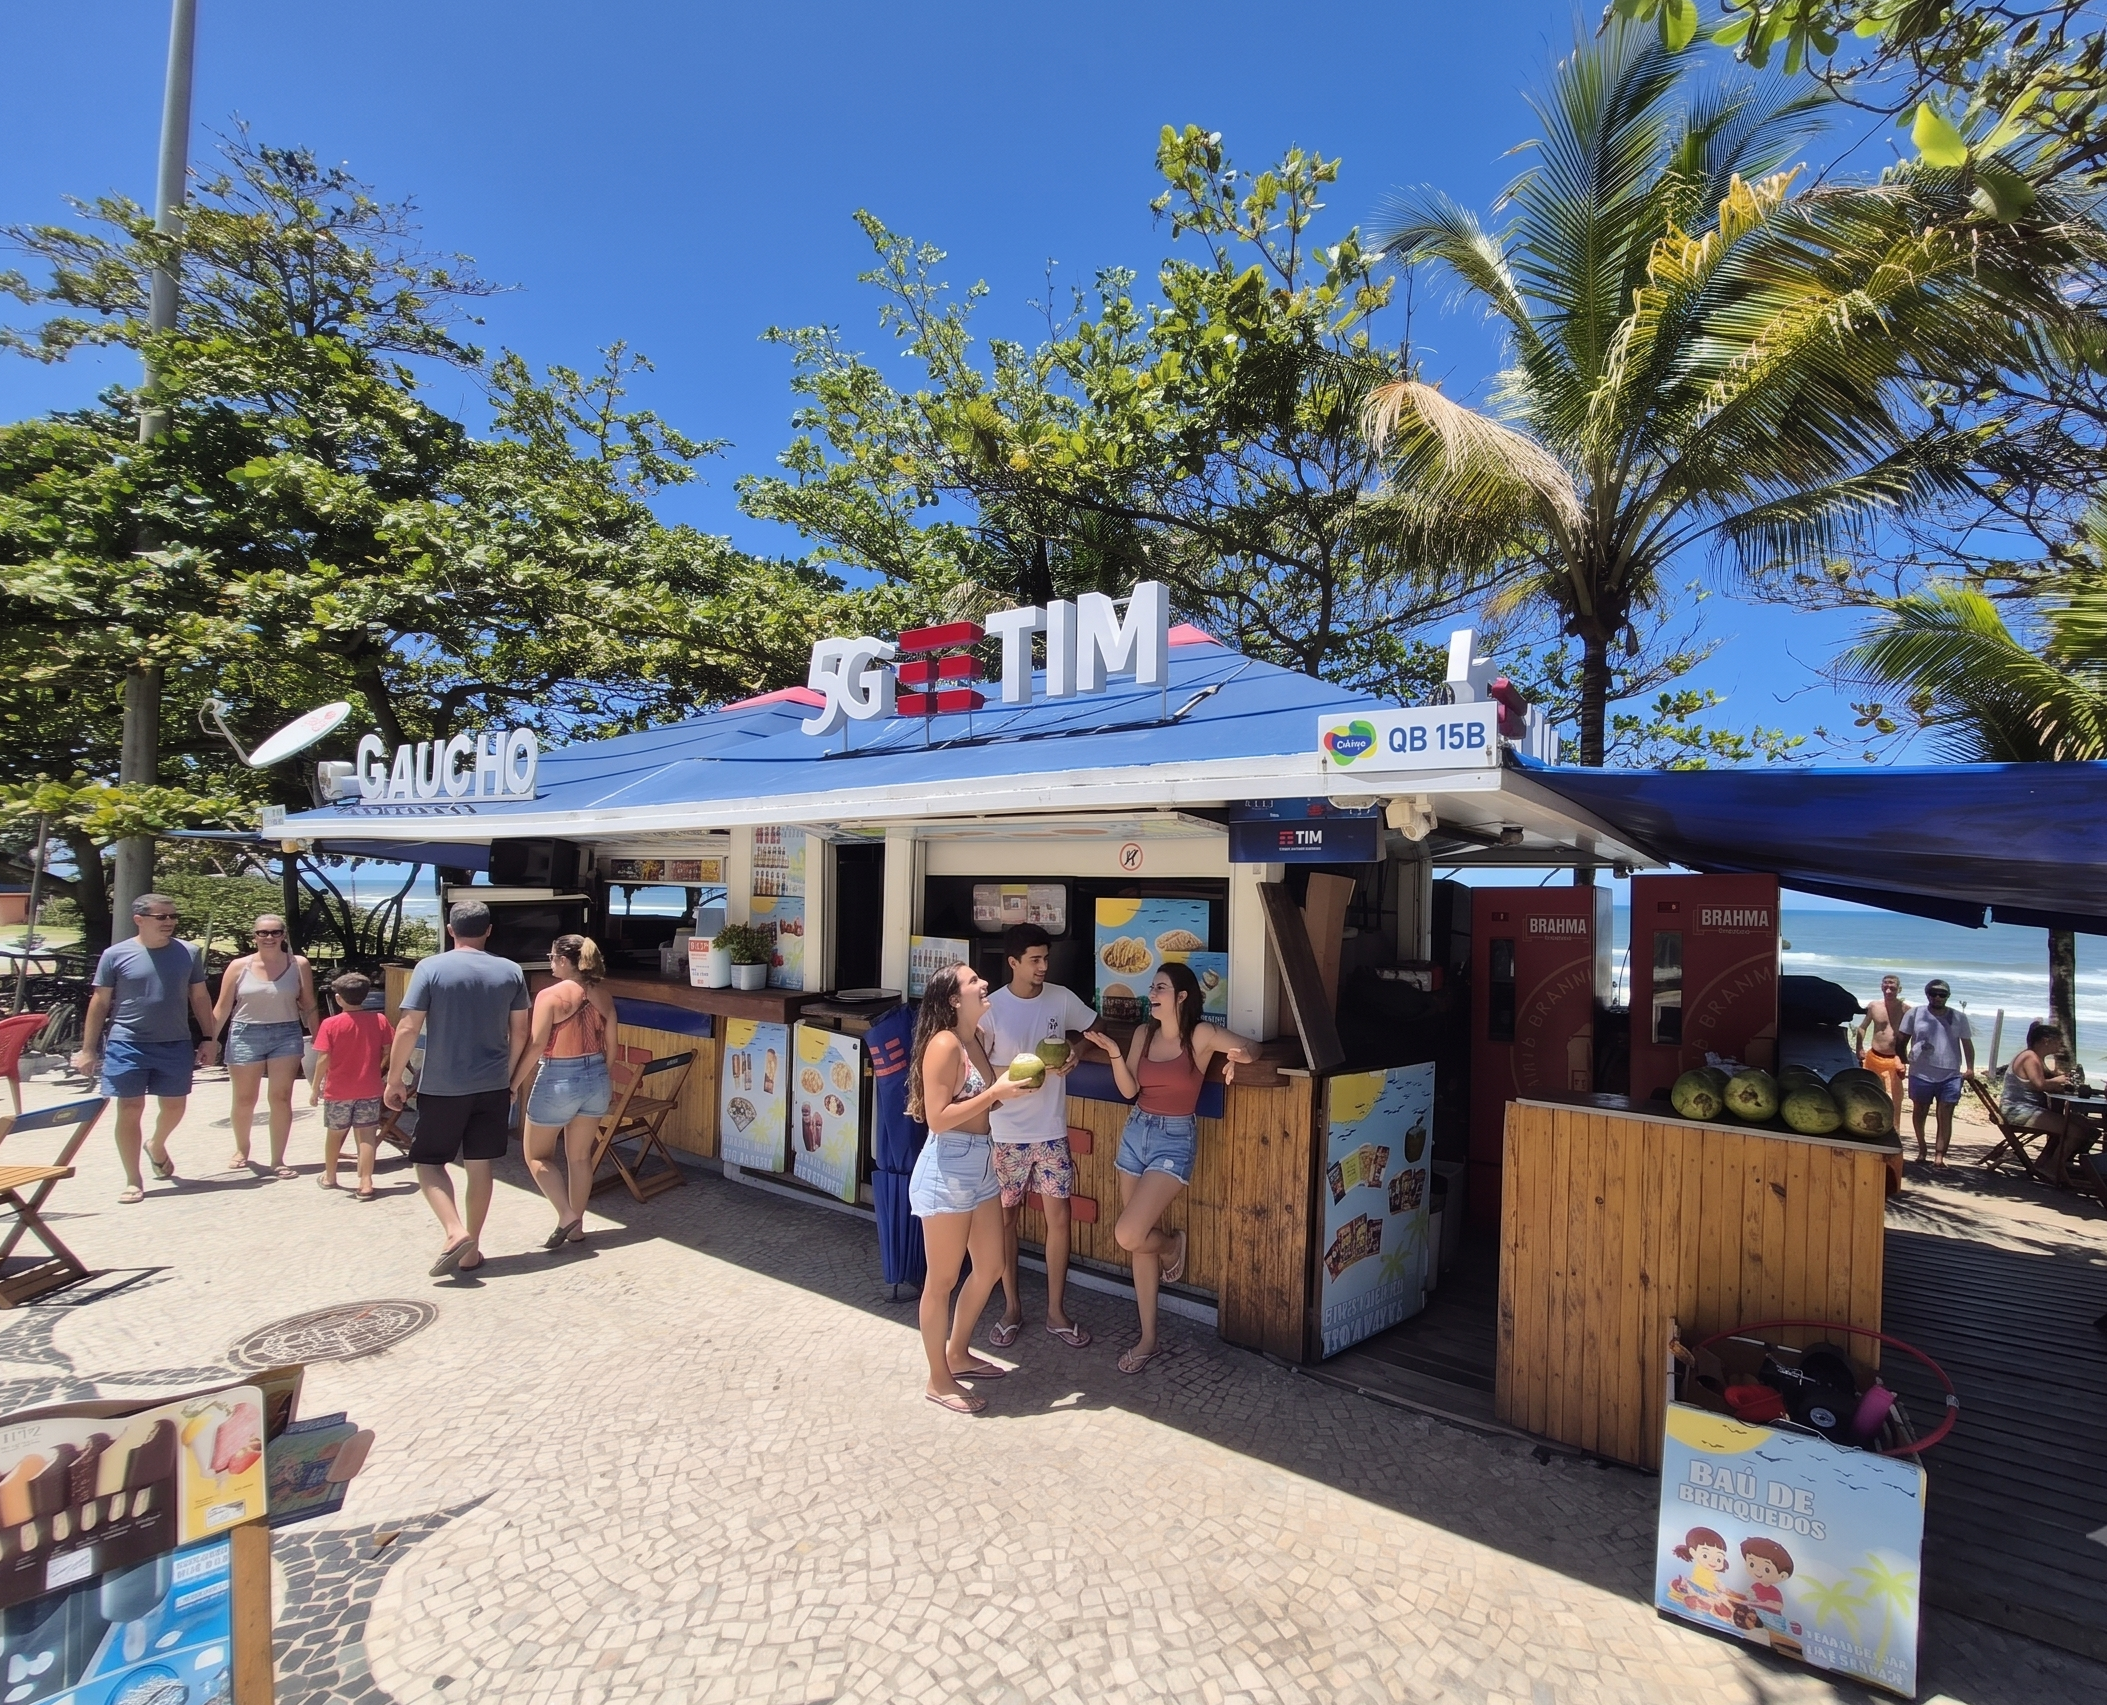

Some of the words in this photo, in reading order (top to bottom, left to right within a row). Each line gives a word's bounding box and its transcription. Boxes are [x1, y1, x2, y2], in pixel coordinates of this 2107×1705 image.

[801, 637, 896, 736] 5G
[985, 580, 1170, 705] TIM
[1388, 726, 1428, 753] QB
[1435, 721, 1486, 750] 15B
[356, 727, 538, 800] GAUCHO
[1295, 830, 1323, 845] TIM
[1529, 918, 1587, 934] BRAHMA
[1701, 909, 1769, 927] BRAHMA
[1688, 1459, 1758, 1503] BAÚ
[1766, 1480, 1816, 1516] DE
[1678, 1483, 1827, 1541] BRINQUEDOS
